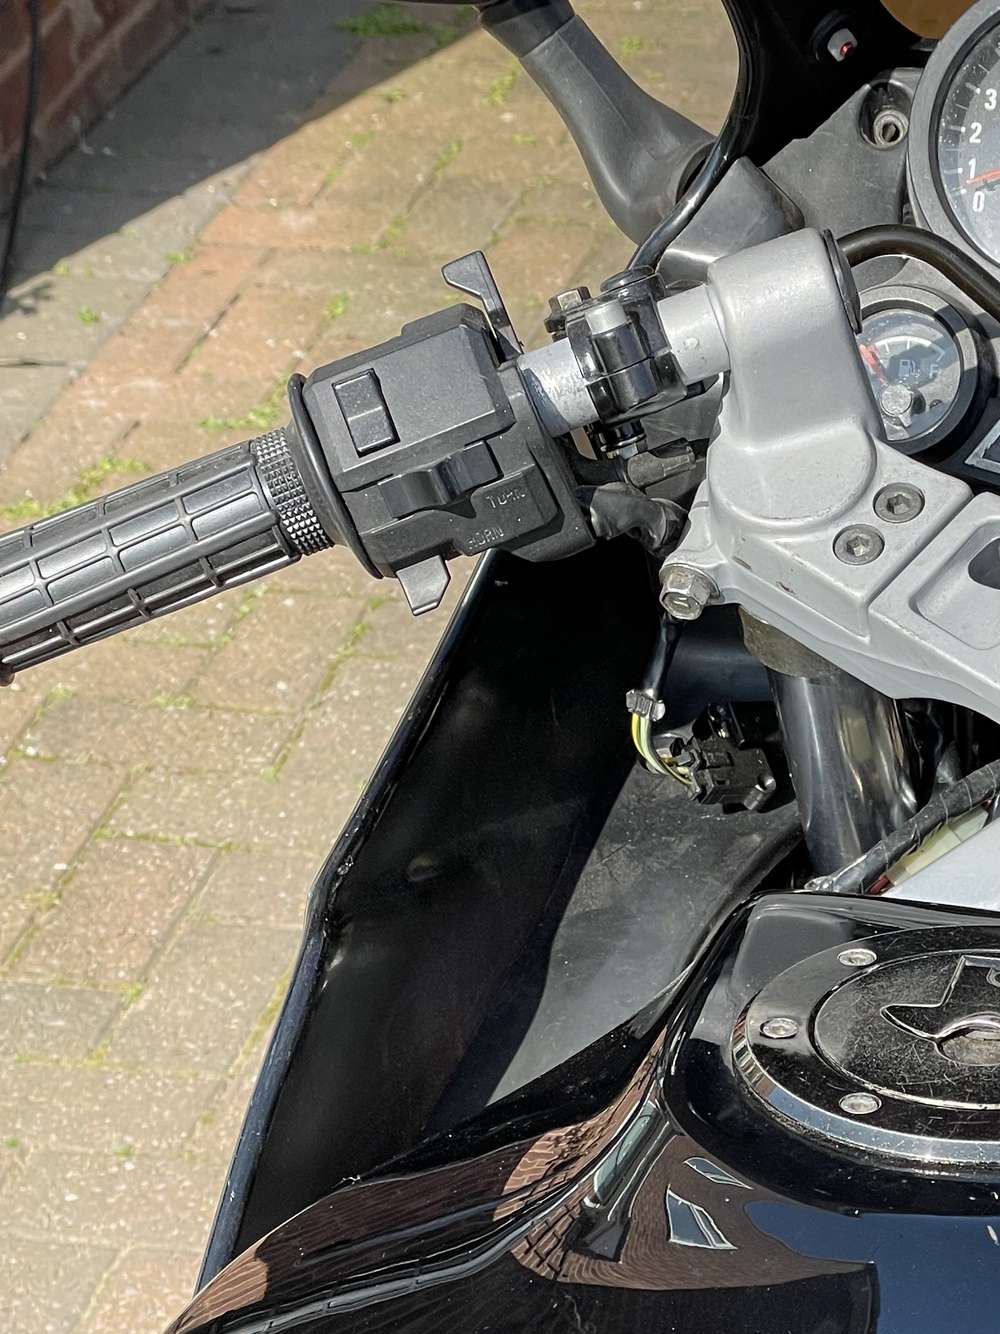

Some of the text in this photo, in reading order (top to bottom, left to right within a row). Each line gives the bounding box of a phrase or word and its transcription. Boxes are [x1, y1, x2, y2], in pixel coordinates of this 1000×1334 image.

[984, 89, 997, 110] 3
[969, 122, 983, 144] 2
[967, 158, 976, 179] 1
[972, 191, 985, 212] 0
[929, 364, 939, 379] F
